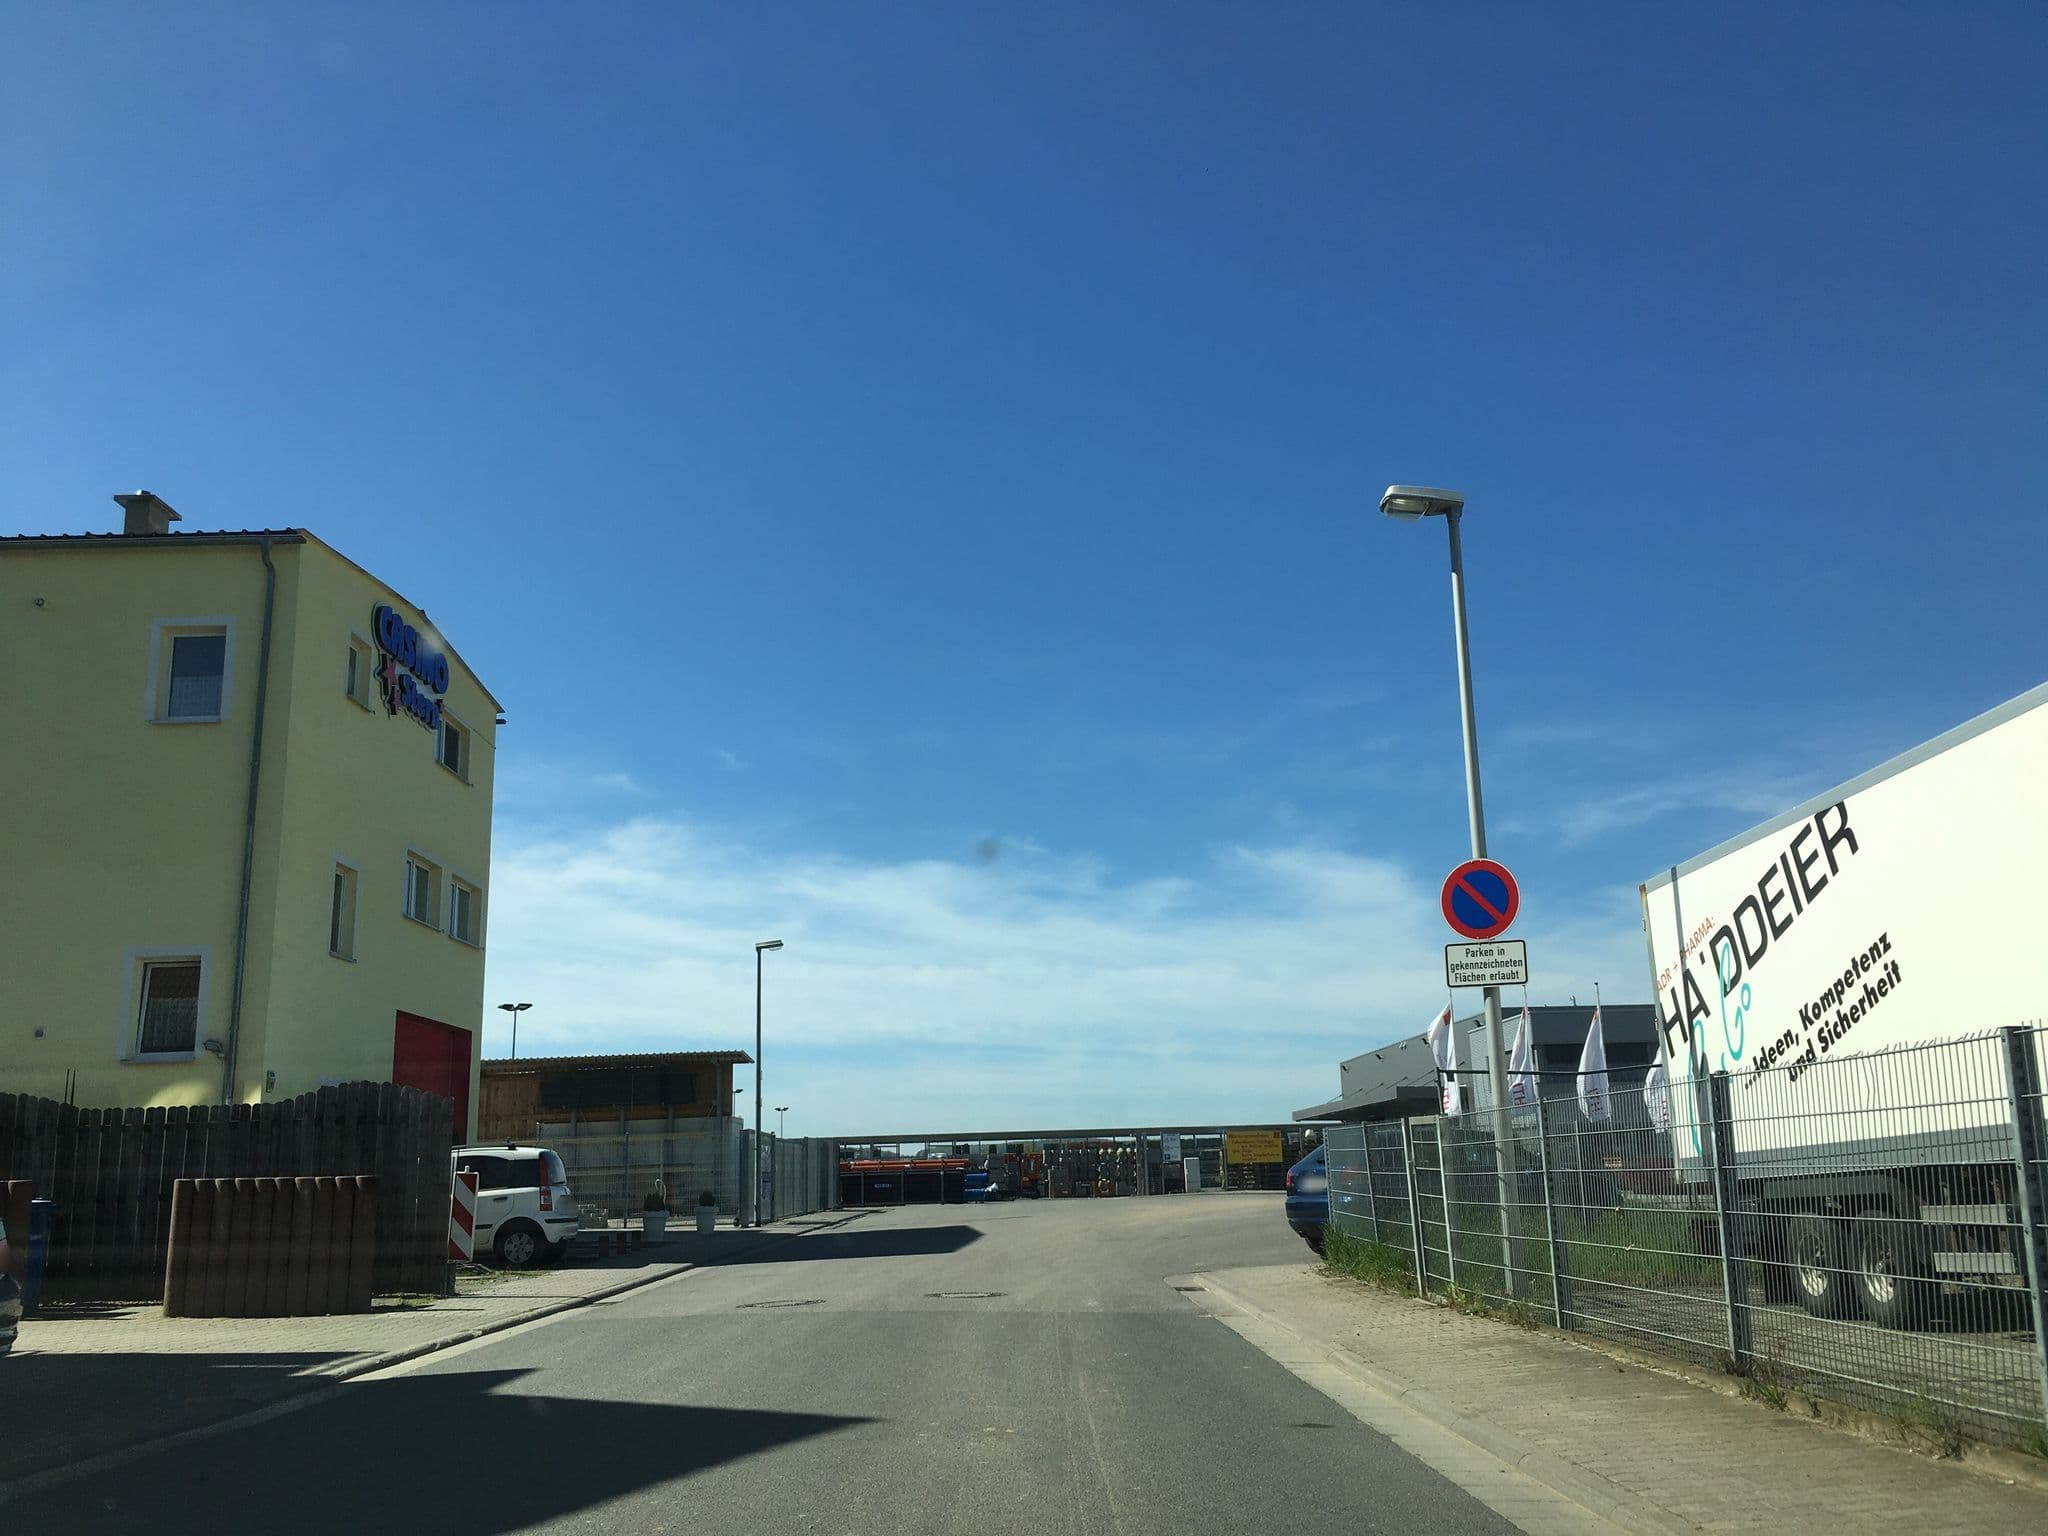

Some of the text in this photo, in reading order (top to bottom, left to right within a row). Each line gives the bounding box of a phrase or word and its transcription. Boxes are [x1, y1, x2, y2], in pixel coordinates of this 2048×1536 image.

[1465, 947, 1505, 958] Parken in
[1450, 958, 1523, 973] gekennzeichneten
[1454, 969, 1520, 983] Flächen erlaubt
[1798, 931, 1892, 1032] Kompetenz
[1788, 959, 1903, 1082] und Sicherheit
